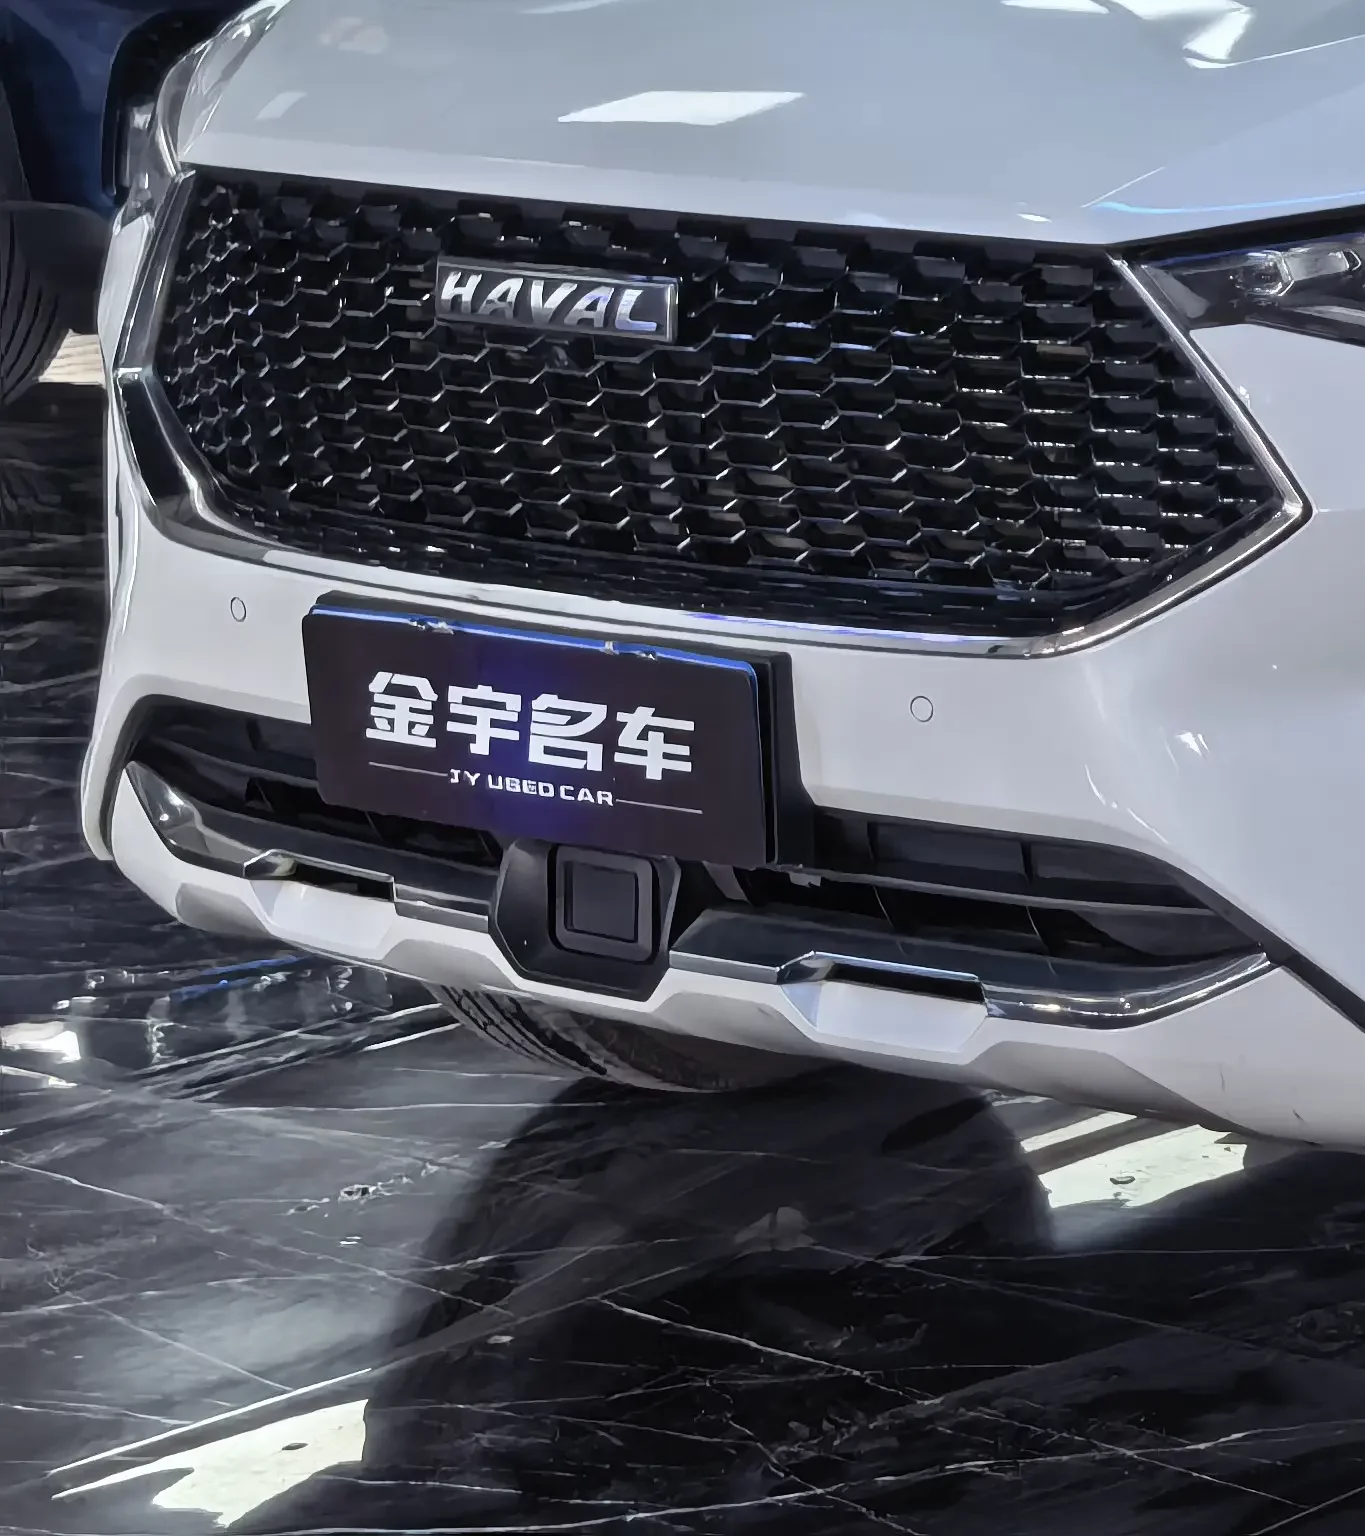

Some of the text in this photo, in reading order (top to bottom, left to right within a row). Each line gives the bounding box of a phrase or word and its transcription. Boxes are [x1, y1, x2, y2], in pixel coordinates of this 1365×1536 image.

[440, 271, 658, 333] HAVAL
[366, 670, 696, 782] 金宇名车
[450, 768, 481, 787] JY
[559, 785, 615, 807] CAR
